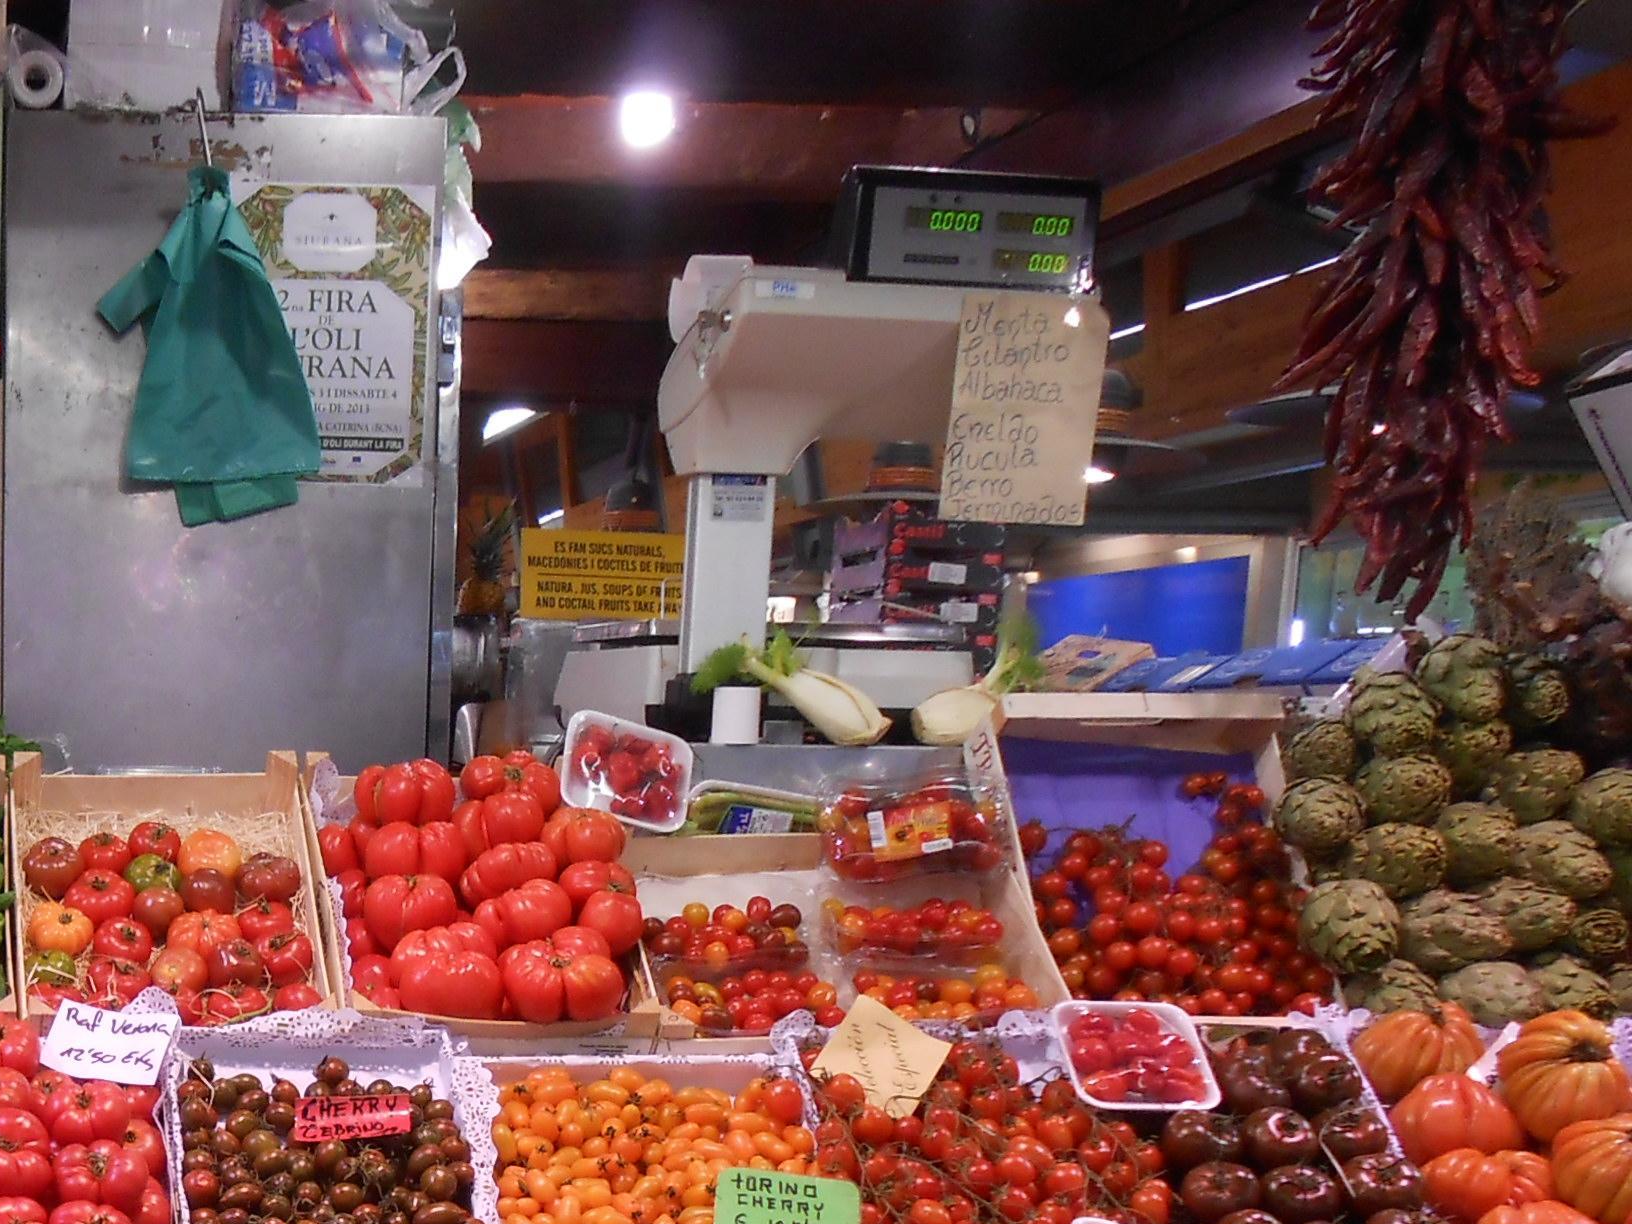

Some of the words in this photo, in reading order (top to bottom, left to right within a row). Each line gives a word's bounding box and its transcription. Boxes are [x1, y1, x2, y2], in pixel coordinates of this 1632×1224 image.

[929, 211, 982, 232] 0.000
[1032, 216, 1071, 237] 0.00
[1028, 253, 1068, 274] 0.00
[308, 289, 378, 314] FIRA
[319, 315, 335, 326] DE
[290, 327, 362, 351] L'OLI
[334, 388, 388, 399] DISSABTE
[958, 370, 1064, 404] Albahaca
[329, 402, 343, 414] DE
[325, 422, 369, 433] CATERINA
[554, 541, 566, 553] ES
[569, 542, 586, 554] FAN
[588, 543, 614, 556] SUCS
[528, 556, 589, 570] MACEDONIES
[597, 559, 637, 572] COCTELS
[639, 561, 653, 573] DE
[636, 586, 648, 597] OF
[536, 595, 556, 609] AND
[558, 597, 596, 611] COCTAIL
[599, 599, 631, 612] FRUITS
[634, 601, 654, 613] TAKE
[66, 1007, 104, 1033] Raf
[737, 1193, 825, 1221] CHERRY
